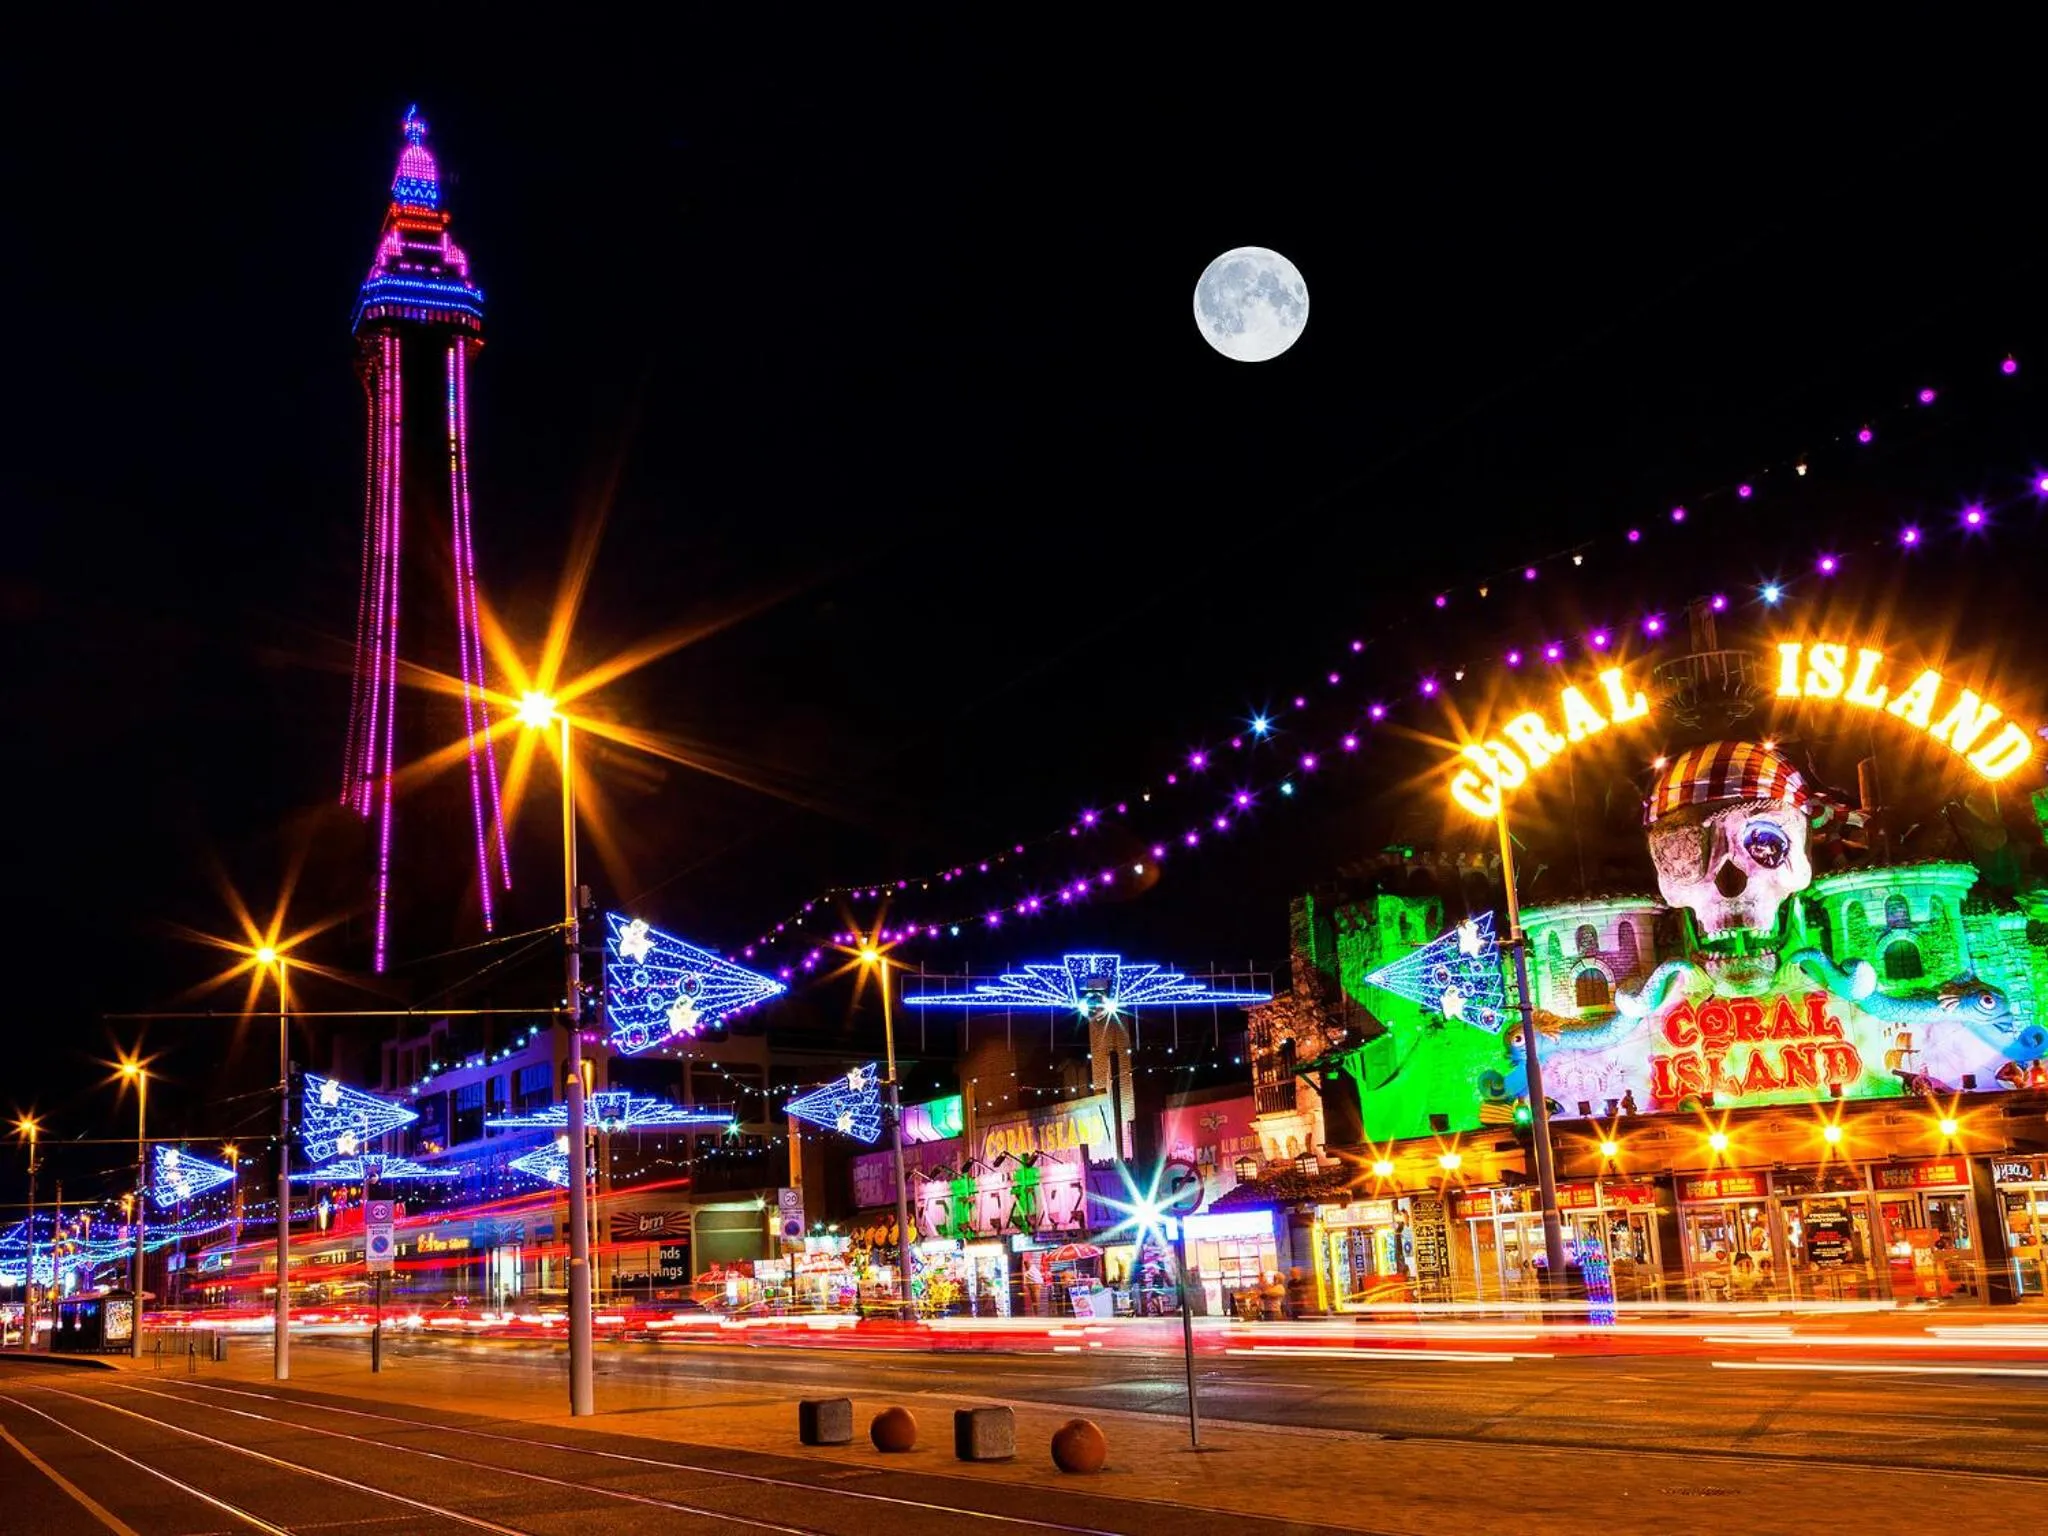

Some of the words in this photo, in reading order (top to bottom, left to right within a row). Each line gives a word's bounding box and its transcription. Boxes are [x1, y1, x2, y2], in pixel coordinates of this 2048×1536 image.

[1450, 667, 1650, 819] CORAL
[1776, 641, 2034, 782] ISLAND
[1663, 990, 1845, 1049] CORAL
[1651, 1041, 1863, 1100] ISLAND
[985, 1124, 1034, 1158] CORAL
[375, 1207, 386, 1216] 20
[786, 1195, 797, 1203] 20
